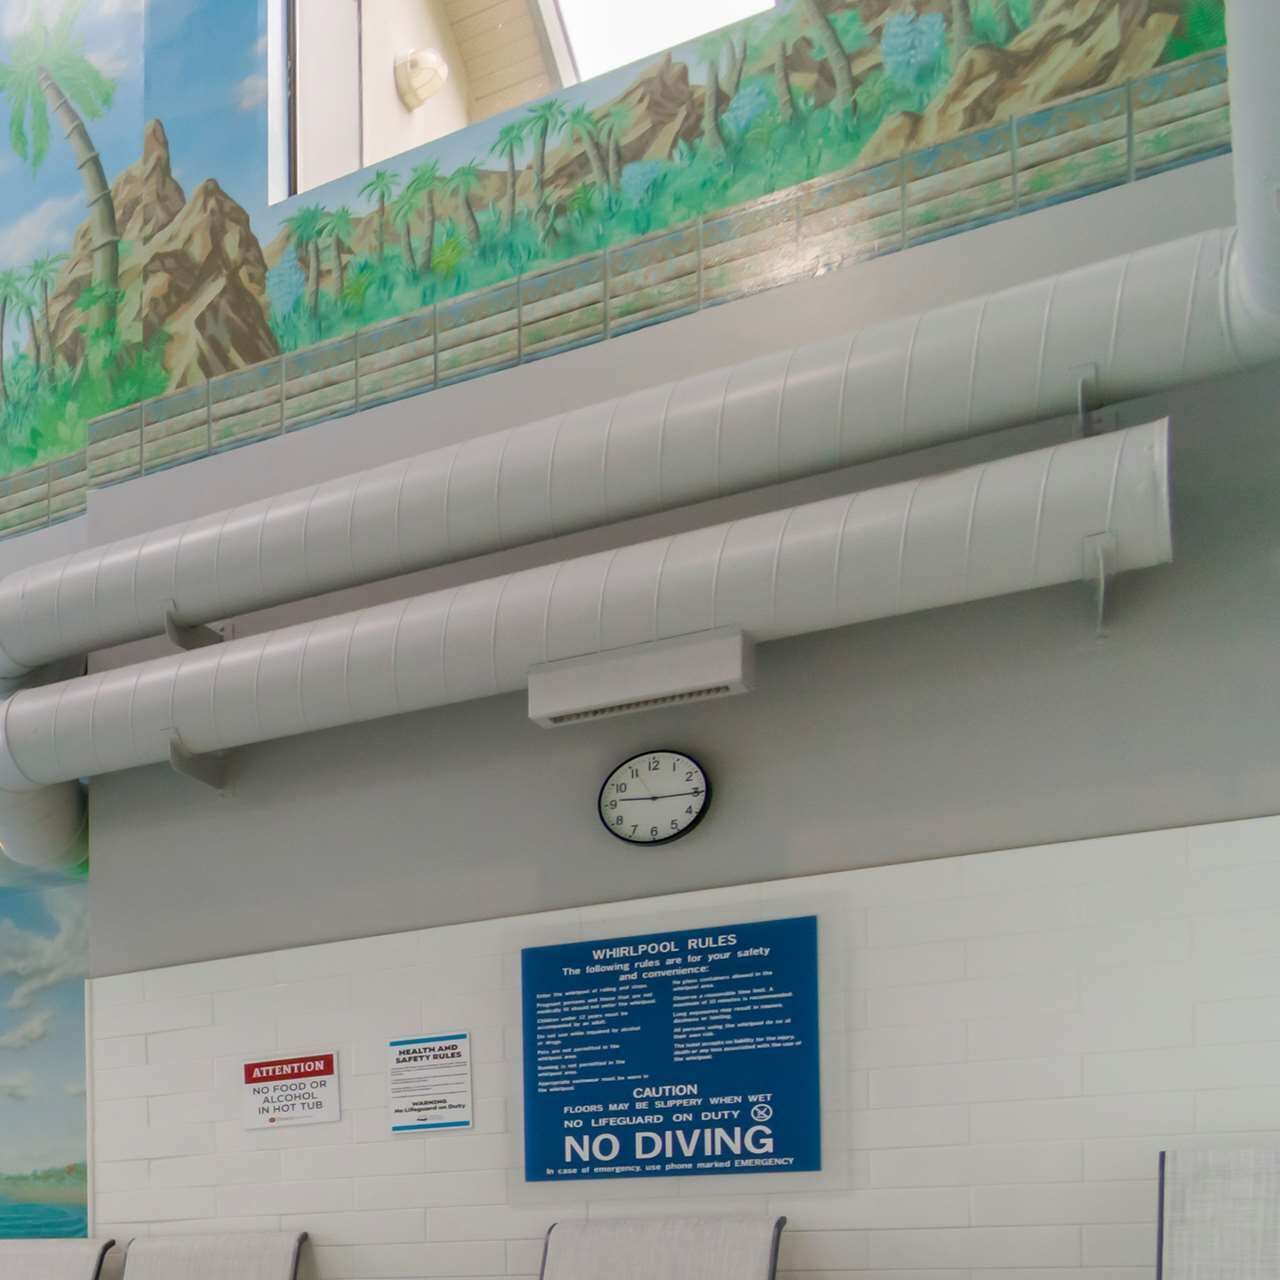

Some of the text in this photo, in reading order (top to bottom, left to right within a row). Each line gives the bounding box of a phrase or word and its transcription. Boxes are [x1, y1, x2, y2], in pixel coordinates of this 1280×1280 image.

[648, 760, 660, 771] 12
[672, 762, 676, 772] 1
[631, 769, 639, 779] 11
[685, 771, 693, 782] 2
[616, 783, 627, 793] 10
[609, 800, 617, 809] 9
[685, 805, 693, 815] 4
[615, 816, 623, 825] 8
[670, 819, 679, 829] 5
[631, 824, 638, 835] 7
[650, 826, 658, 836] 6
[592, 934, 737, 960] WHIRLPOOL RULES
[562, 946, 770, 976] The following rules are for your safety
[619, 971, 637, 981] and
[399, 1044, 458, 1057] HEALTH AND
[395, 1051, 462, 1064] SAFETY RULES
[252, 1060, 325, 1078] ATTENTION
[252, 1079, 327, 1095] NO FOOD OR
[633, 1084, 698, 1099] CAUTION
[262, 1091, 317, 1105] ALCOHOL
[564, 1093, 773, 1114] FLOORS MAY BE SLIPPERY WHEN WET
[258, 1100, 323, 1115] IN HOT TUB
[564, 1110, 741, 1129] NO LIFEGUARD ON DUTY
[564, 1125, 774, 1163] NO DIVING
[557, 1167, 577, 1175] case
[665, 1161, 693, 1171] phone
[697, 1159, 731, 1169] marked
[734, 1157, 794, 1167] EMERGENCY
